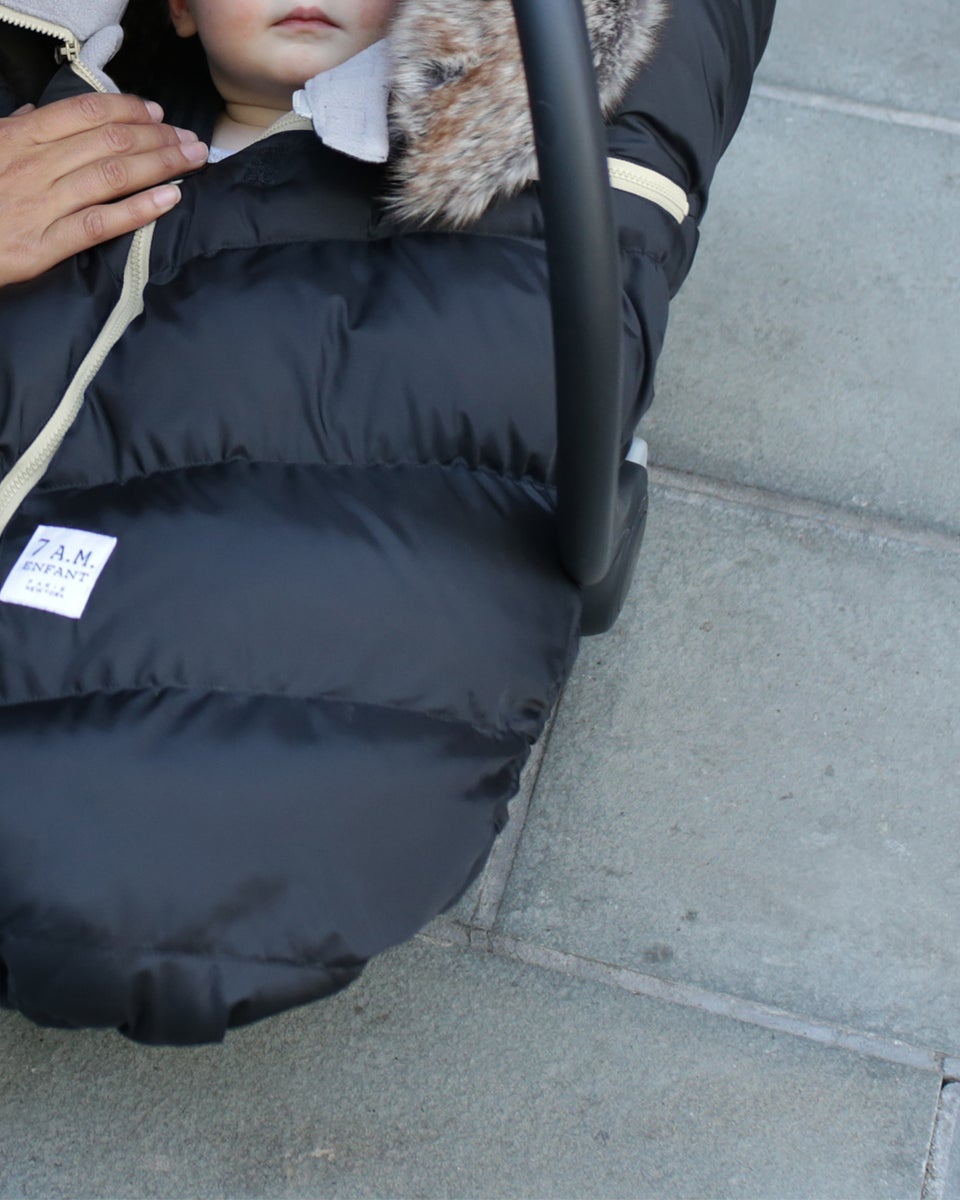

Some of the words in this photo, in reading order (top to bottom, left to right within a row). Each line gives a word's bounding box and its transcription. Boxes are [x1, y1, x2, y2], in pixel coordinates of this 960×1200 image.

[32, 538, 50, 556] 7
[50, 545, 94, 569] A.M.
[22, 561, 89, 582] ENFANT
